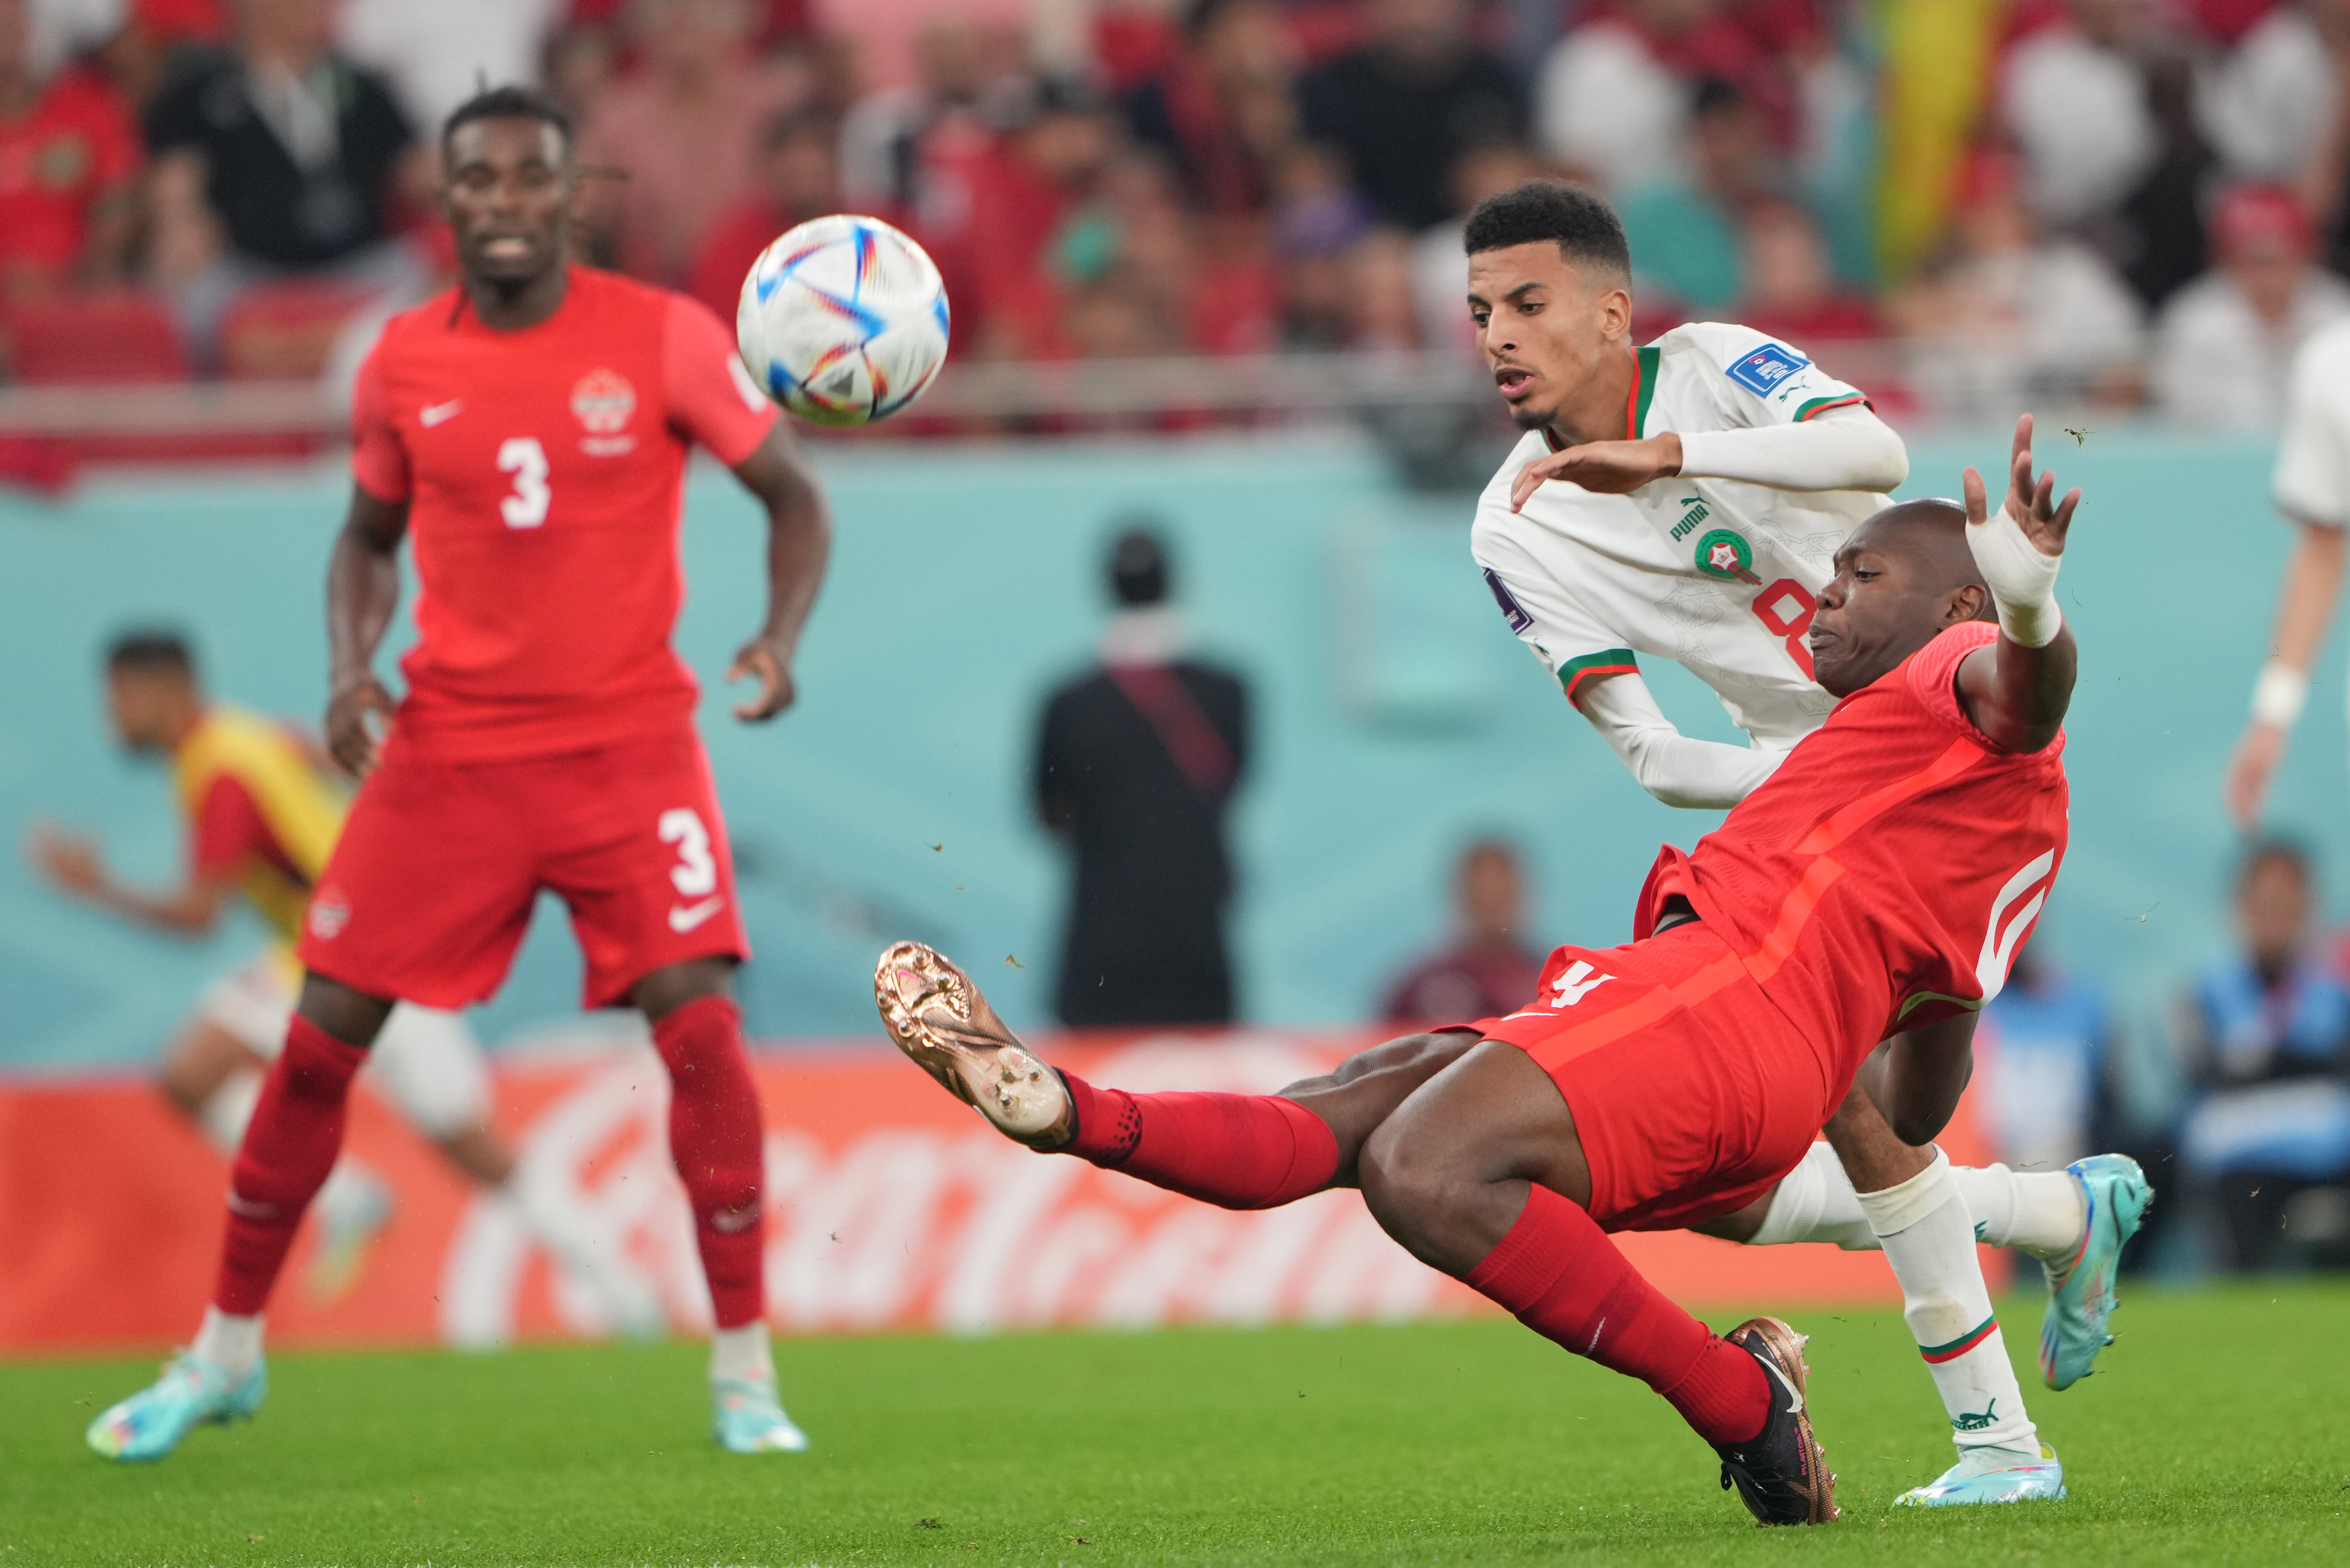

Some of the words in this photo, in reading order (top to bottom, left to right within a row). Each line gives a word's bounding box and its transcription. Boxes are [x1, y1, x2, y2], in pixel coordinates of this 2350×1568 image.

[496, 437, 551, 529] 3
[1670, 503, 1709, 542] PUMA
[1752, 578, 1817, 681] 8
[659, 808, 716, 896] 3
